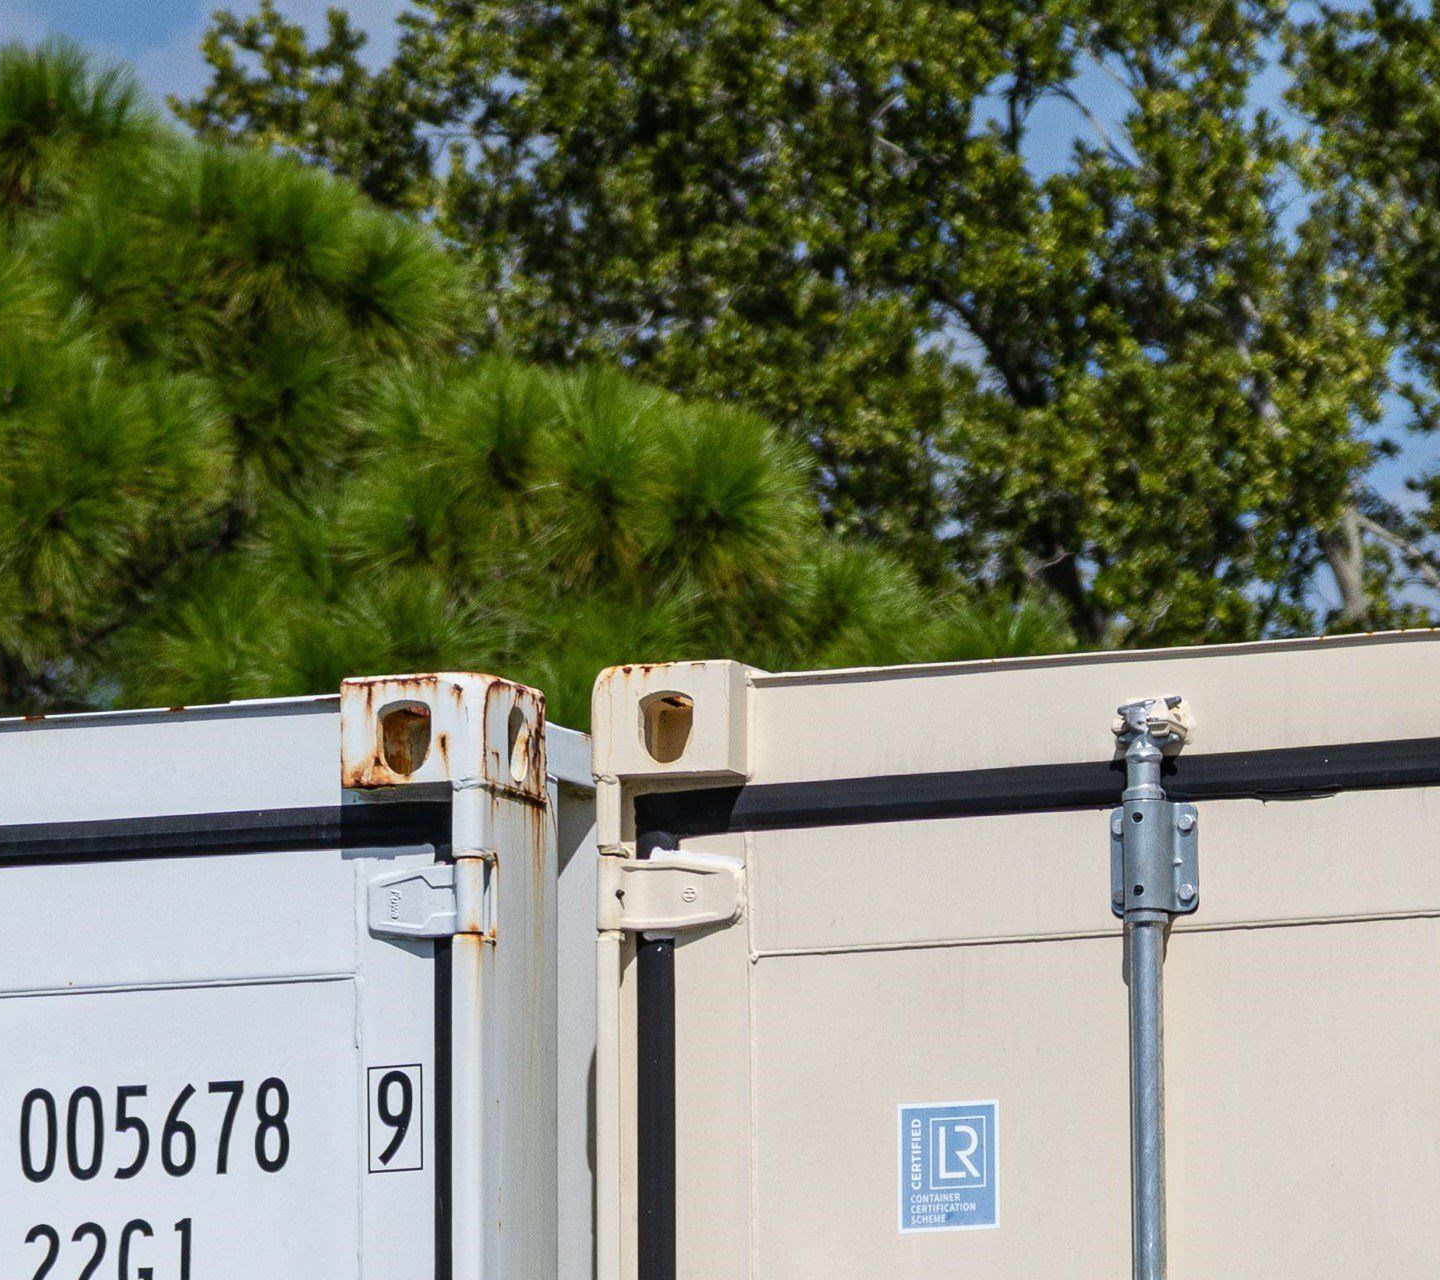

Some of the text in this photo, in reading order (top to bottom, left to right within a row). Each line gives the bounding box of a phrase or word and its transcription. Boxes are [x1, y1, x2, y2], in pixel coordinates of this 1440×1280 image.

[20, 1077, 290, 1183] 005678
[377, 1070, 413, 1166] 9
[911, 1118, 922, 1191] CERTIFIED
[938, 1125, 981, 1179] LR
[910, 1192, 961, 1204] CONTAINER
[910, 1202, 977, 1214] CERTIFICATION
[910, 1213, 947, 1225] SCHEME
